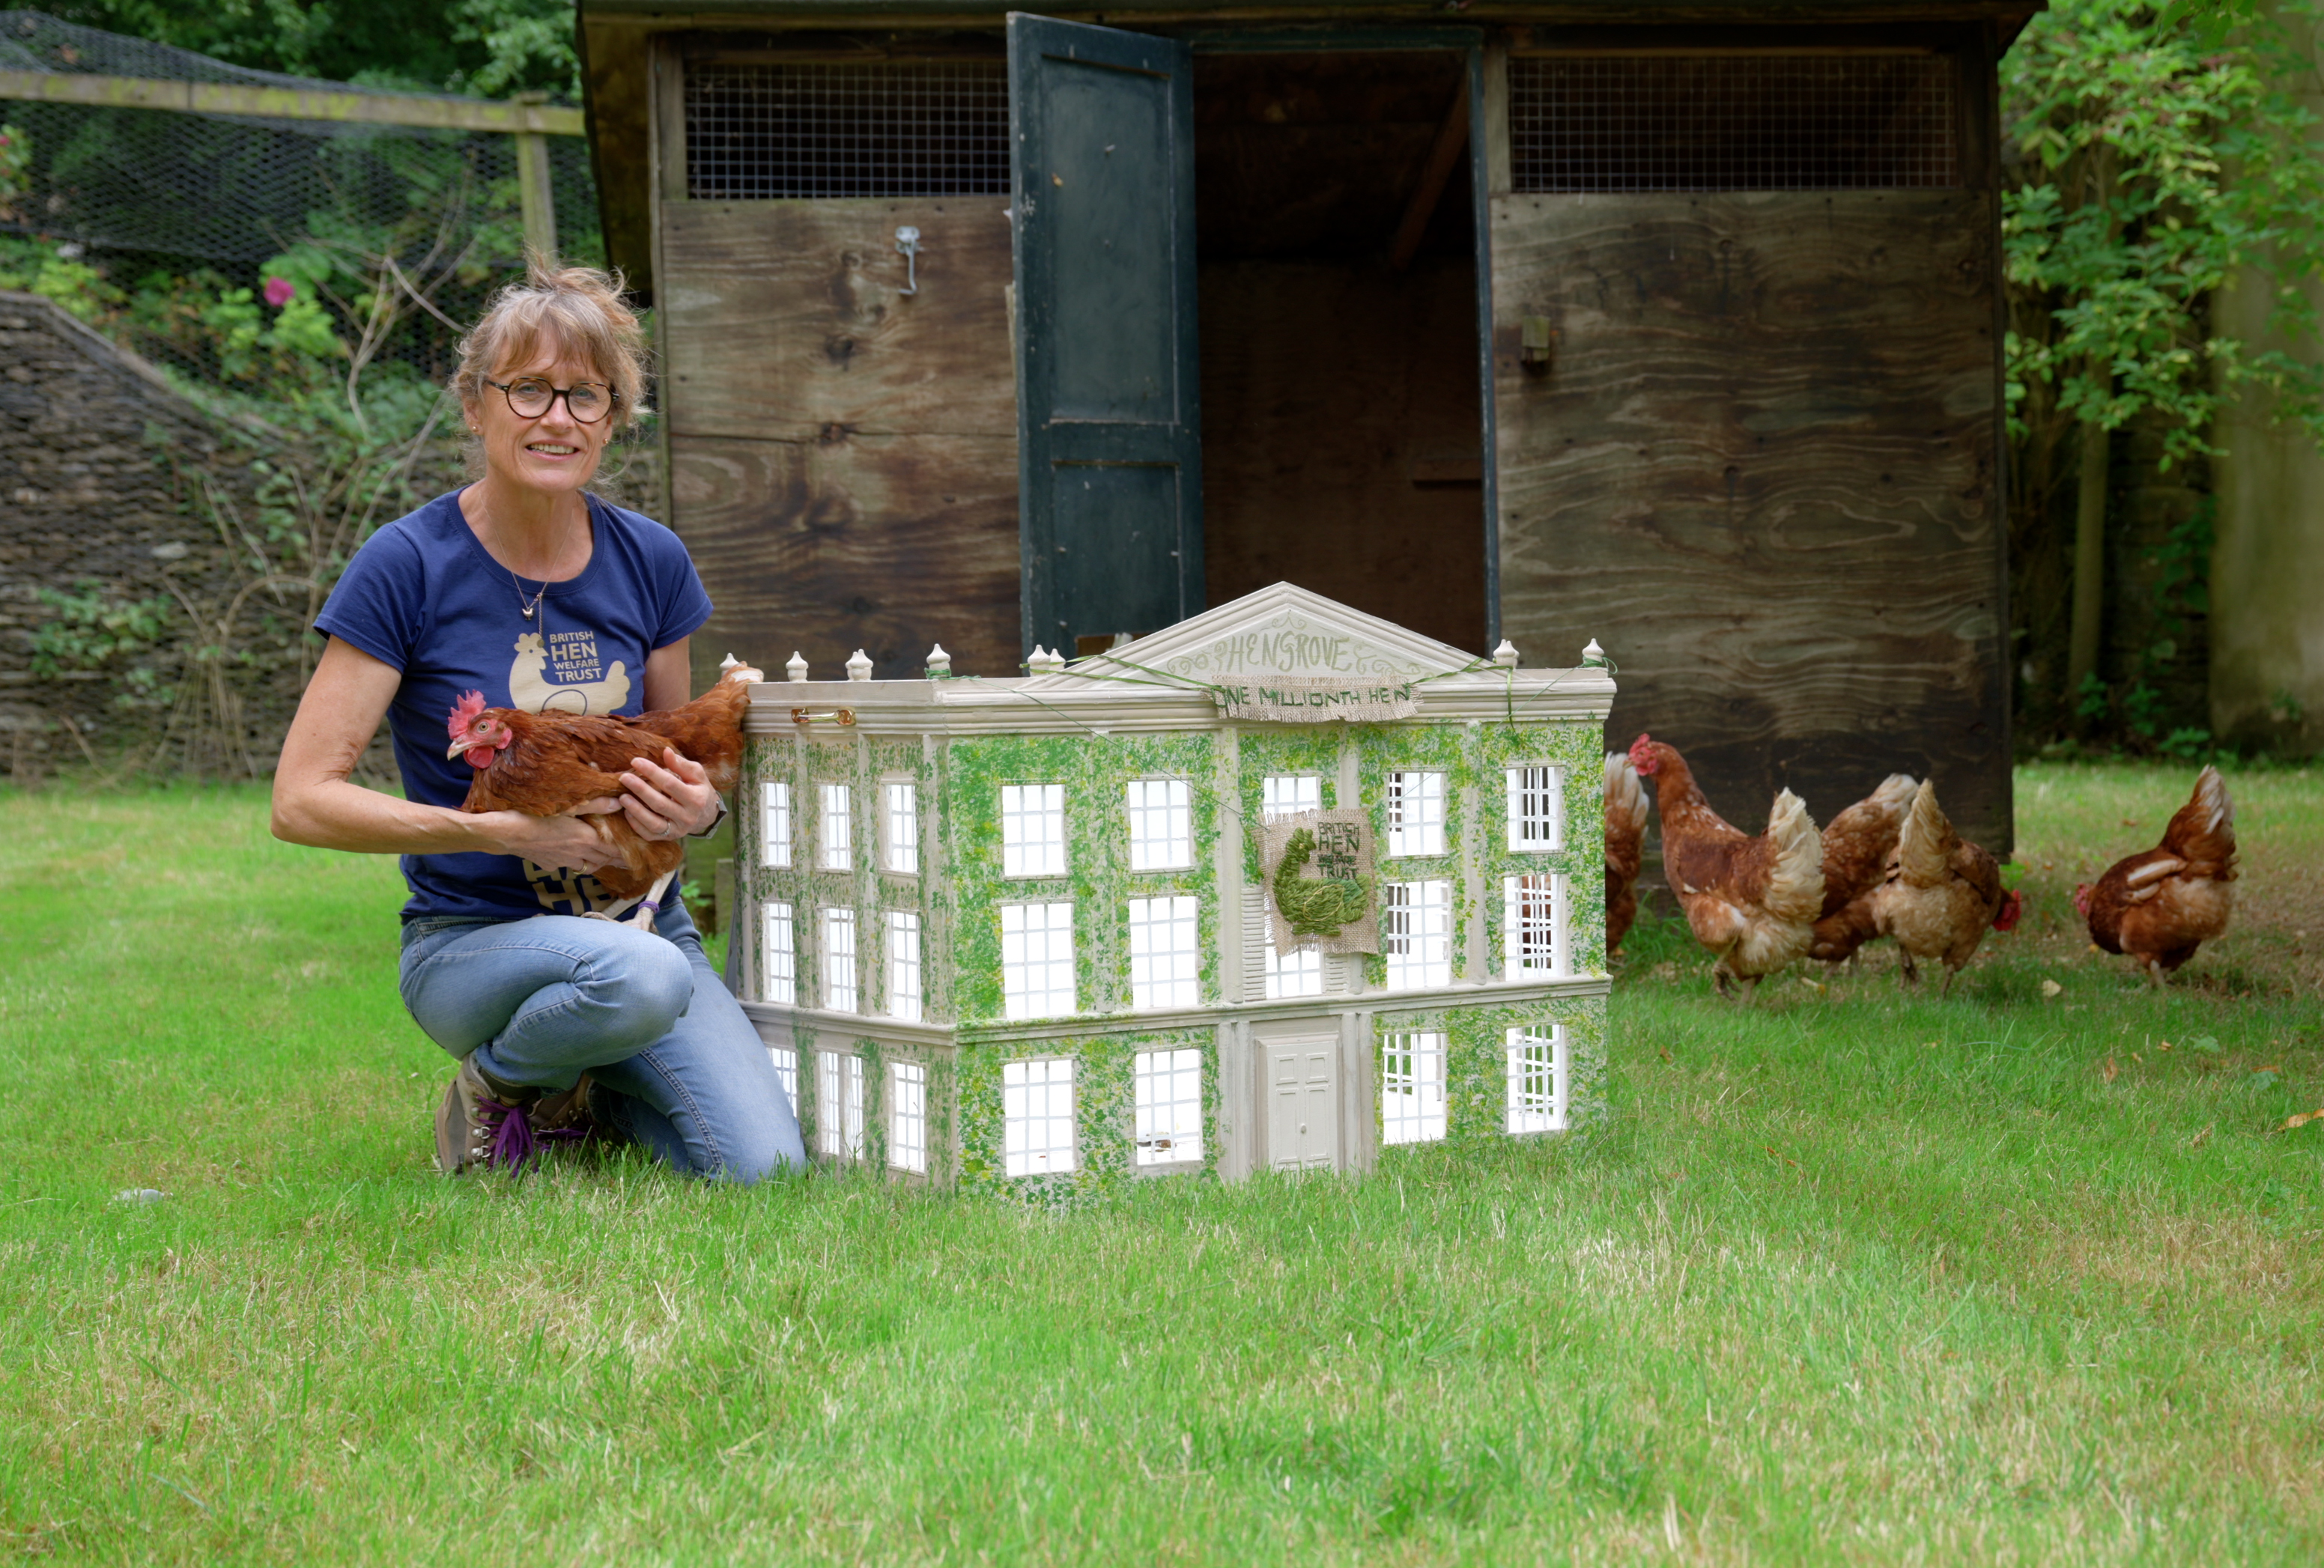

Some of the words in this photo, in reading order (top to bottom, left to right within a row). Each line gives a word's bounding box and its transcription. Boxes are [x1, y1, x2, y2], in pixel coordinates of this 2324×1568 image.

[549, 631, 594, 643] BRITISH
[550, 642, 598, 661] HEN
[1227, 630, 1353, 672] HENGROVE
[553, 658, 600, 670] WELFARE
[555, 668, 602, 682] TRUST
[1211, 684, 1251, 708] ONE
[1369, 682, 1411, 704] HEN
[1317, 822, 1360, 835] BRITISH
[1319, 834, 1360, 855] HEN
